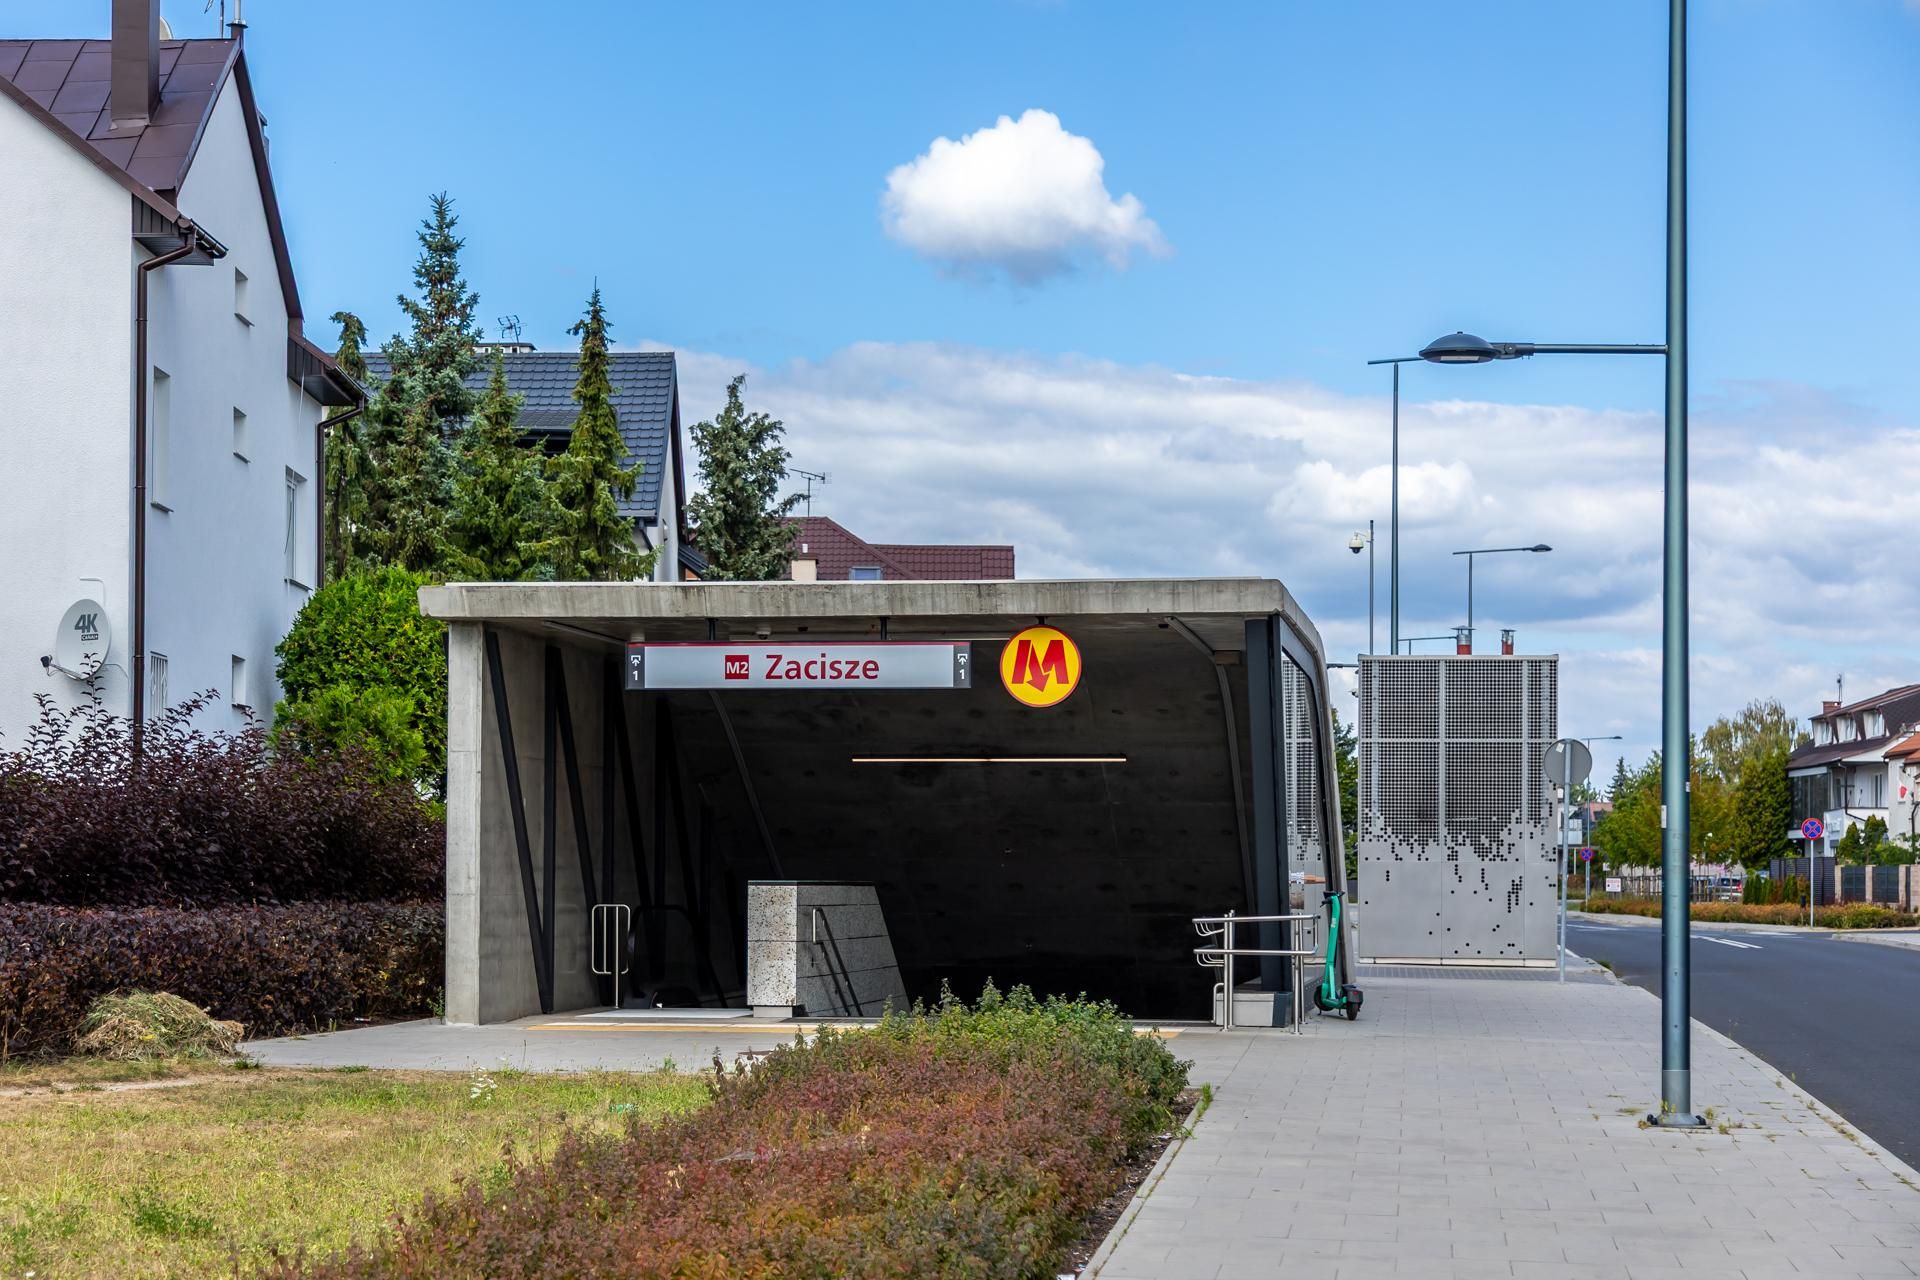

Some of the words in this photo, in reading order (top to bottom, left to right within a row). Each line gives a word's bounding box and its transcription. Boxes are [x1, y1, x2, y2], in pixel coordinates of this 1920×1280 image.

[74, 613, 98, 633] 4K
[726, 661, 749, 674] M2
[765, 653, 880, 680] Zacisze
[959, 668, 965, 680] 1
[632, 670, 638, 681] 1
